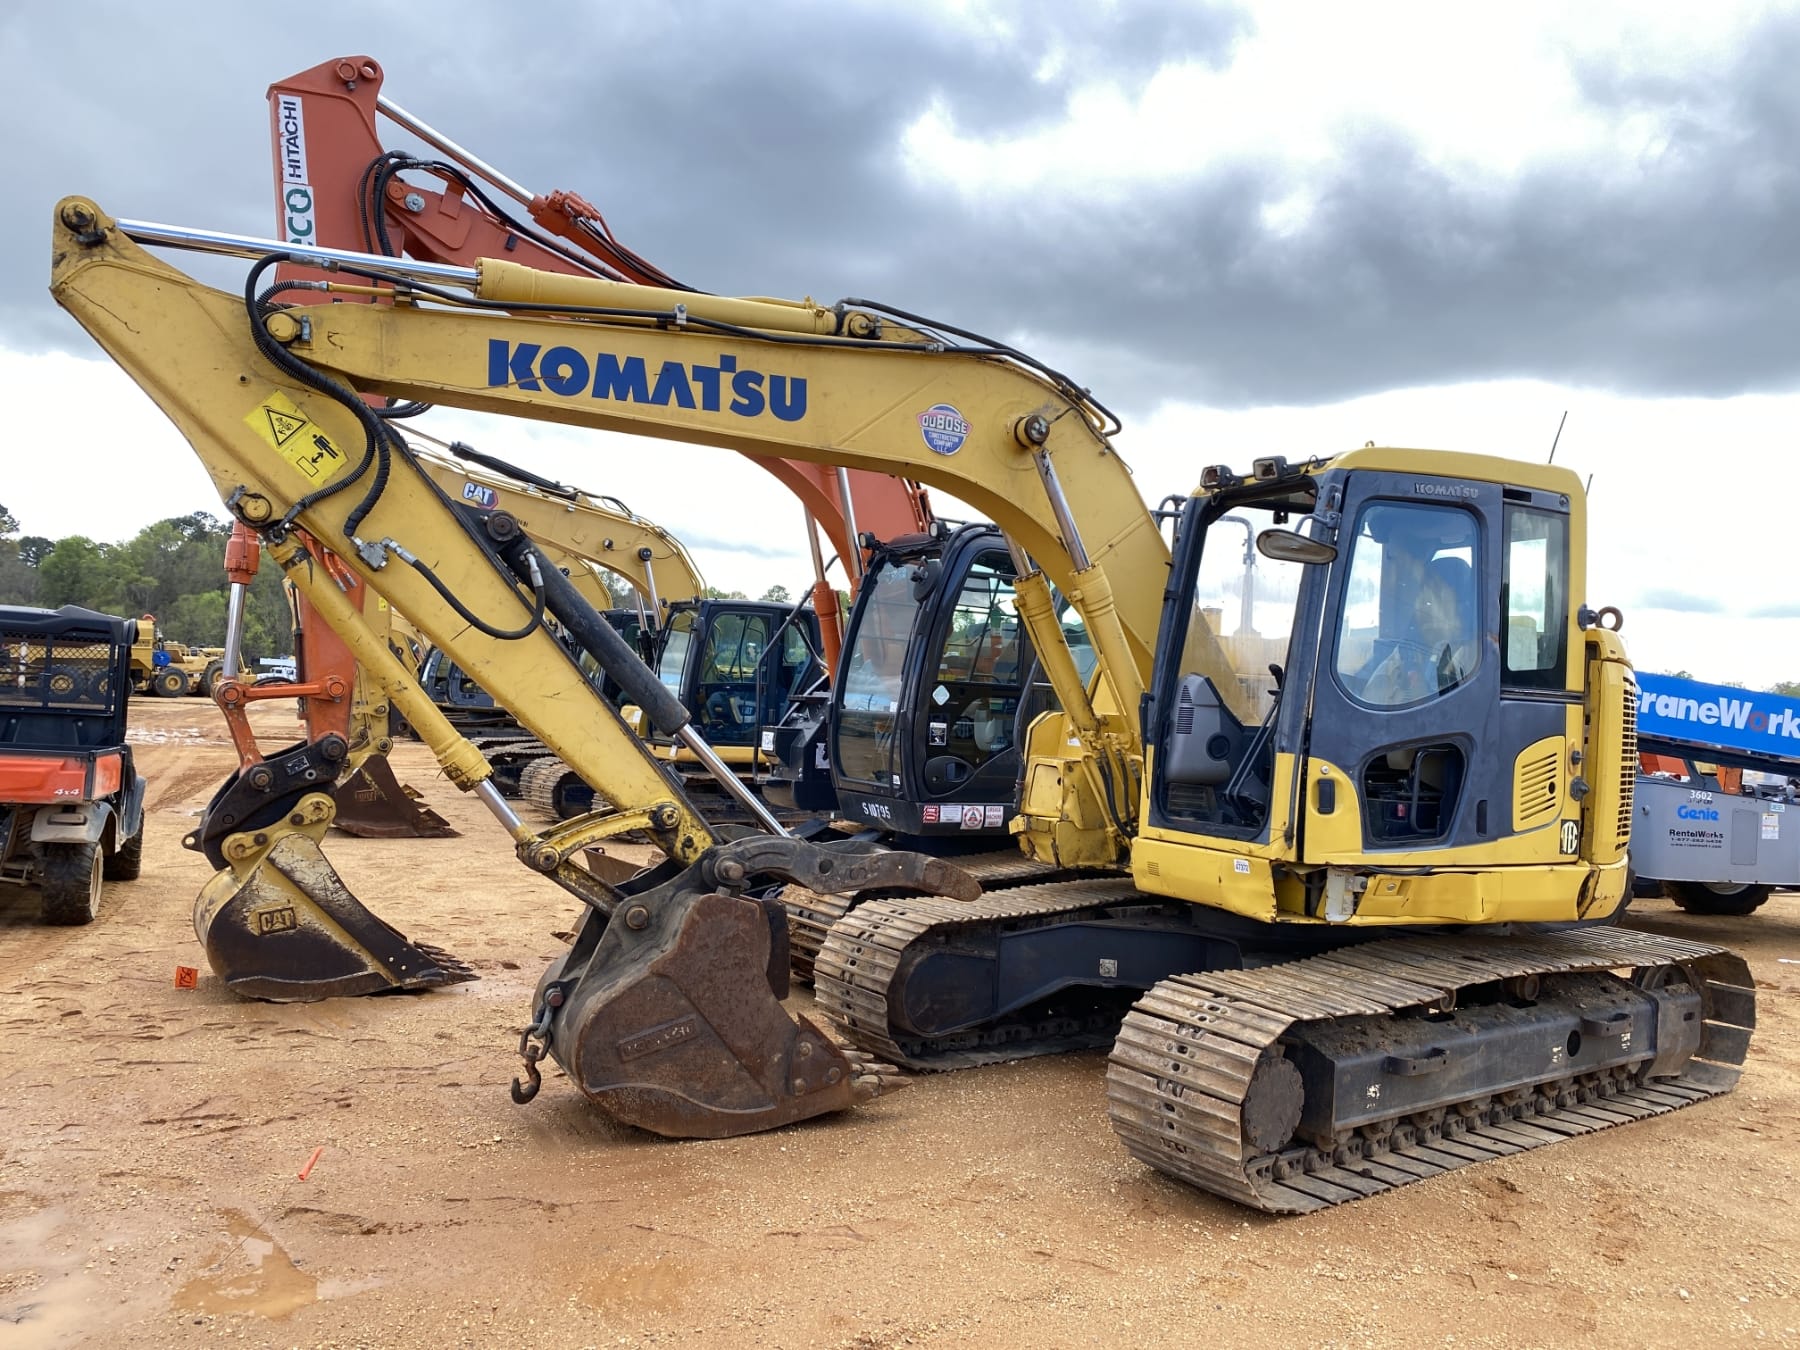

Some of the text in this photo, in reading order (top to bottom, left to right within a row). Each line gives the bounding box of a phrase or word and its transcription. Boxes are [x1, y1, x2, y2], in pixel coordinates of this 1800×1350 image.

[283, 101, 302, 178] HITACHI
[488, 338, 807, 422] KOMATSU
[463, 482, 493, 504] CAT
[1415, 483, 1478, 499] KOMATSU
[1690, 789, 1712, 801] 3602
[1677, 805, 1719, 821] Genie
[1669, 829, 1724, 839] RentalWorks
[260, 910, 292, 931] CAT
